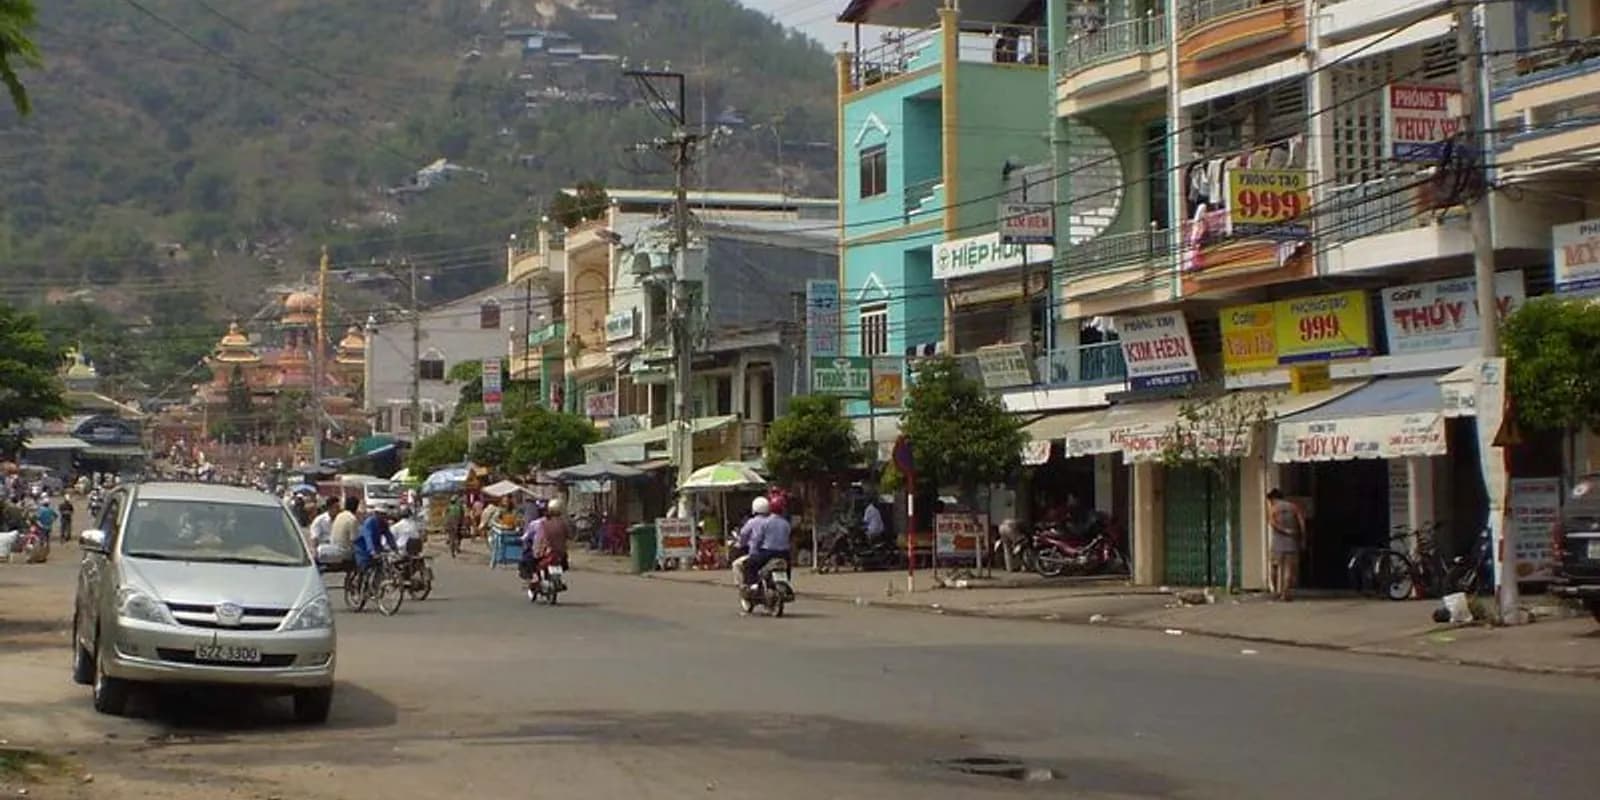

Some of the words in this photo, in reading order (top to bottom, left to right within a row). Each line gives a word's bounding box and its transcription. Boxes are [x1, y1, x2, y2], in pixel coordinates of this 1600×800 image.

[1238, 188, 1301, 218] 999
[950, 241, 990, 270] HIỆP
[1299, 313, 1340, 342] 999
[1393, 298, 1465, 330] THÚY
[1124, 341, 1154, 363] KIM
[1330, 435, 1351, 455] VY
